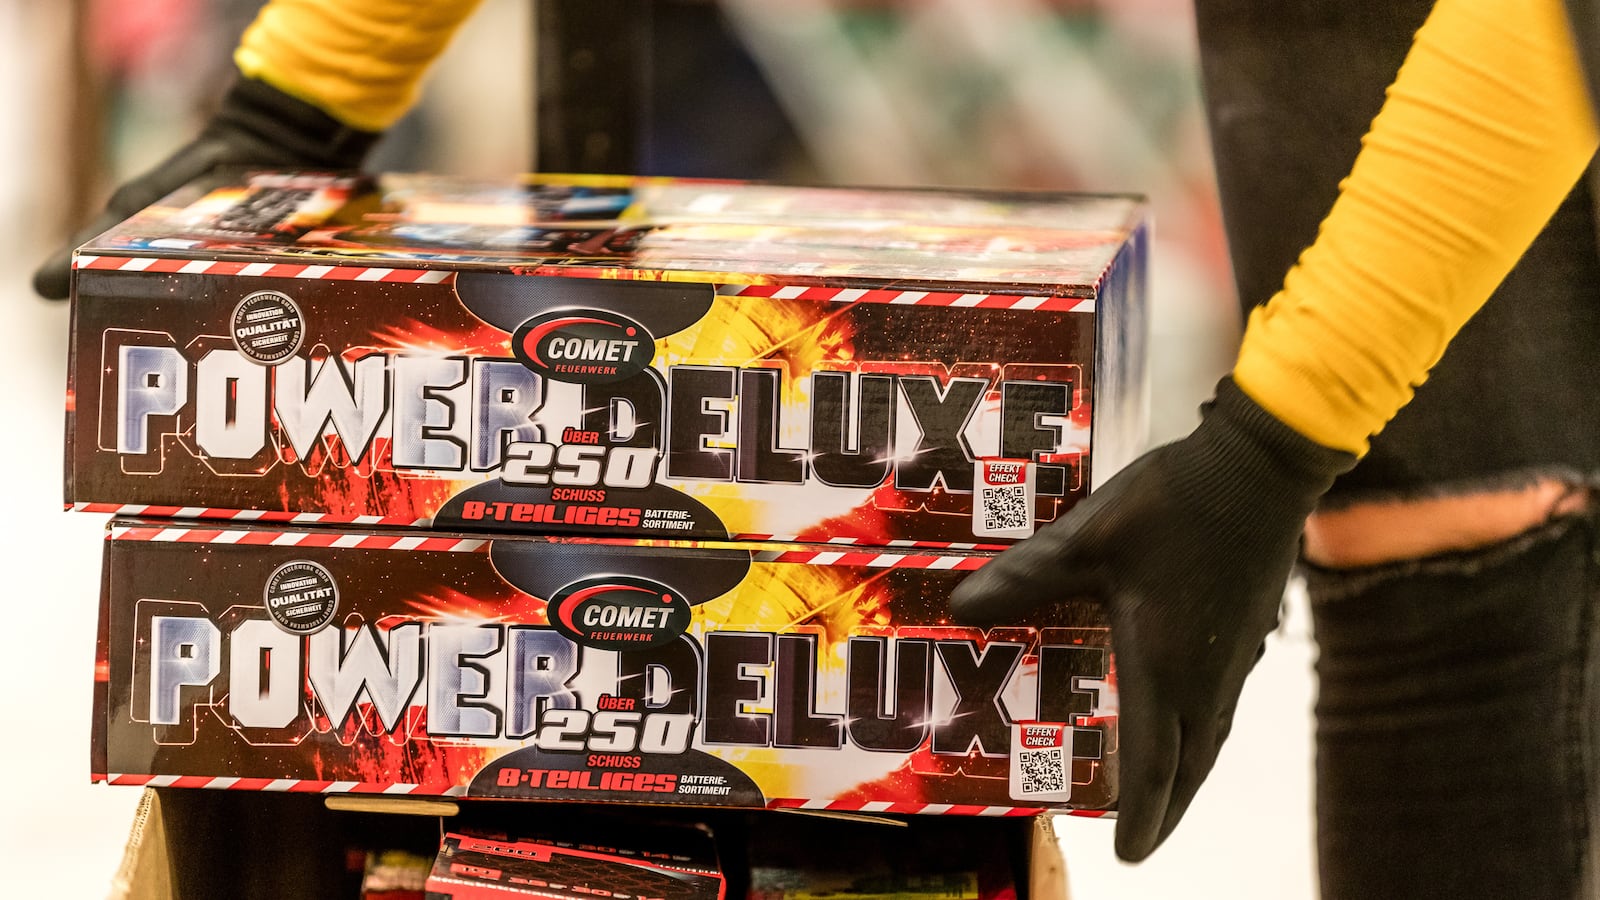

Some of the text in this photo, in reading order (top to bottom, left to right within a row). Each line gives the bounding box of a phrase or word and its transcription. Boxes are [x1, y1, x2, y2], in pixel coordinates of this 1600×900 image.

[246, 308, 284, 321] INNOVATION
[236, 317, 299, 339] QUALITÄT
[251, 335, 288, 347] SICHERHEIT
[548, 337, 639, 362] COMET
[555, 364, 618, 375] FEUERWERK
[117, 345, 1072, 498] POWER DELUXE
[563, 427, 600, 444] ÜBER
[502, 441, 659, 489] 250
[989, 464, 1022, 473] EFFEKT
[989, 473, 1019, 483] CHECK
[551, 488, 606, 503] SCHUSS
[644, 509, 692, 520] BATTERIE-
[642, 519, 695, 531] SORTIMENT
[280, 577, 318, 591] INNOVATION
[285, 604, 322, 617] SICHERHEIT
[583, 604, 675, 629] COMET
[590, 631, 654, 642] FEUERWERK
[150, 615, 1106, 759] POWER DELUXE
[599, 694, 635, 711] ÜBER
[537, 709, 695, 754] 250
[1026, 728, 1059, 736] EFFEKT
[1026, 736, 1055, 746] CHECK
[587, 754, 642, 769] SCHUSS
[680, 775, 728, 785] BATTERIE-
[678, 784, 732, 796] SORTIMENT
